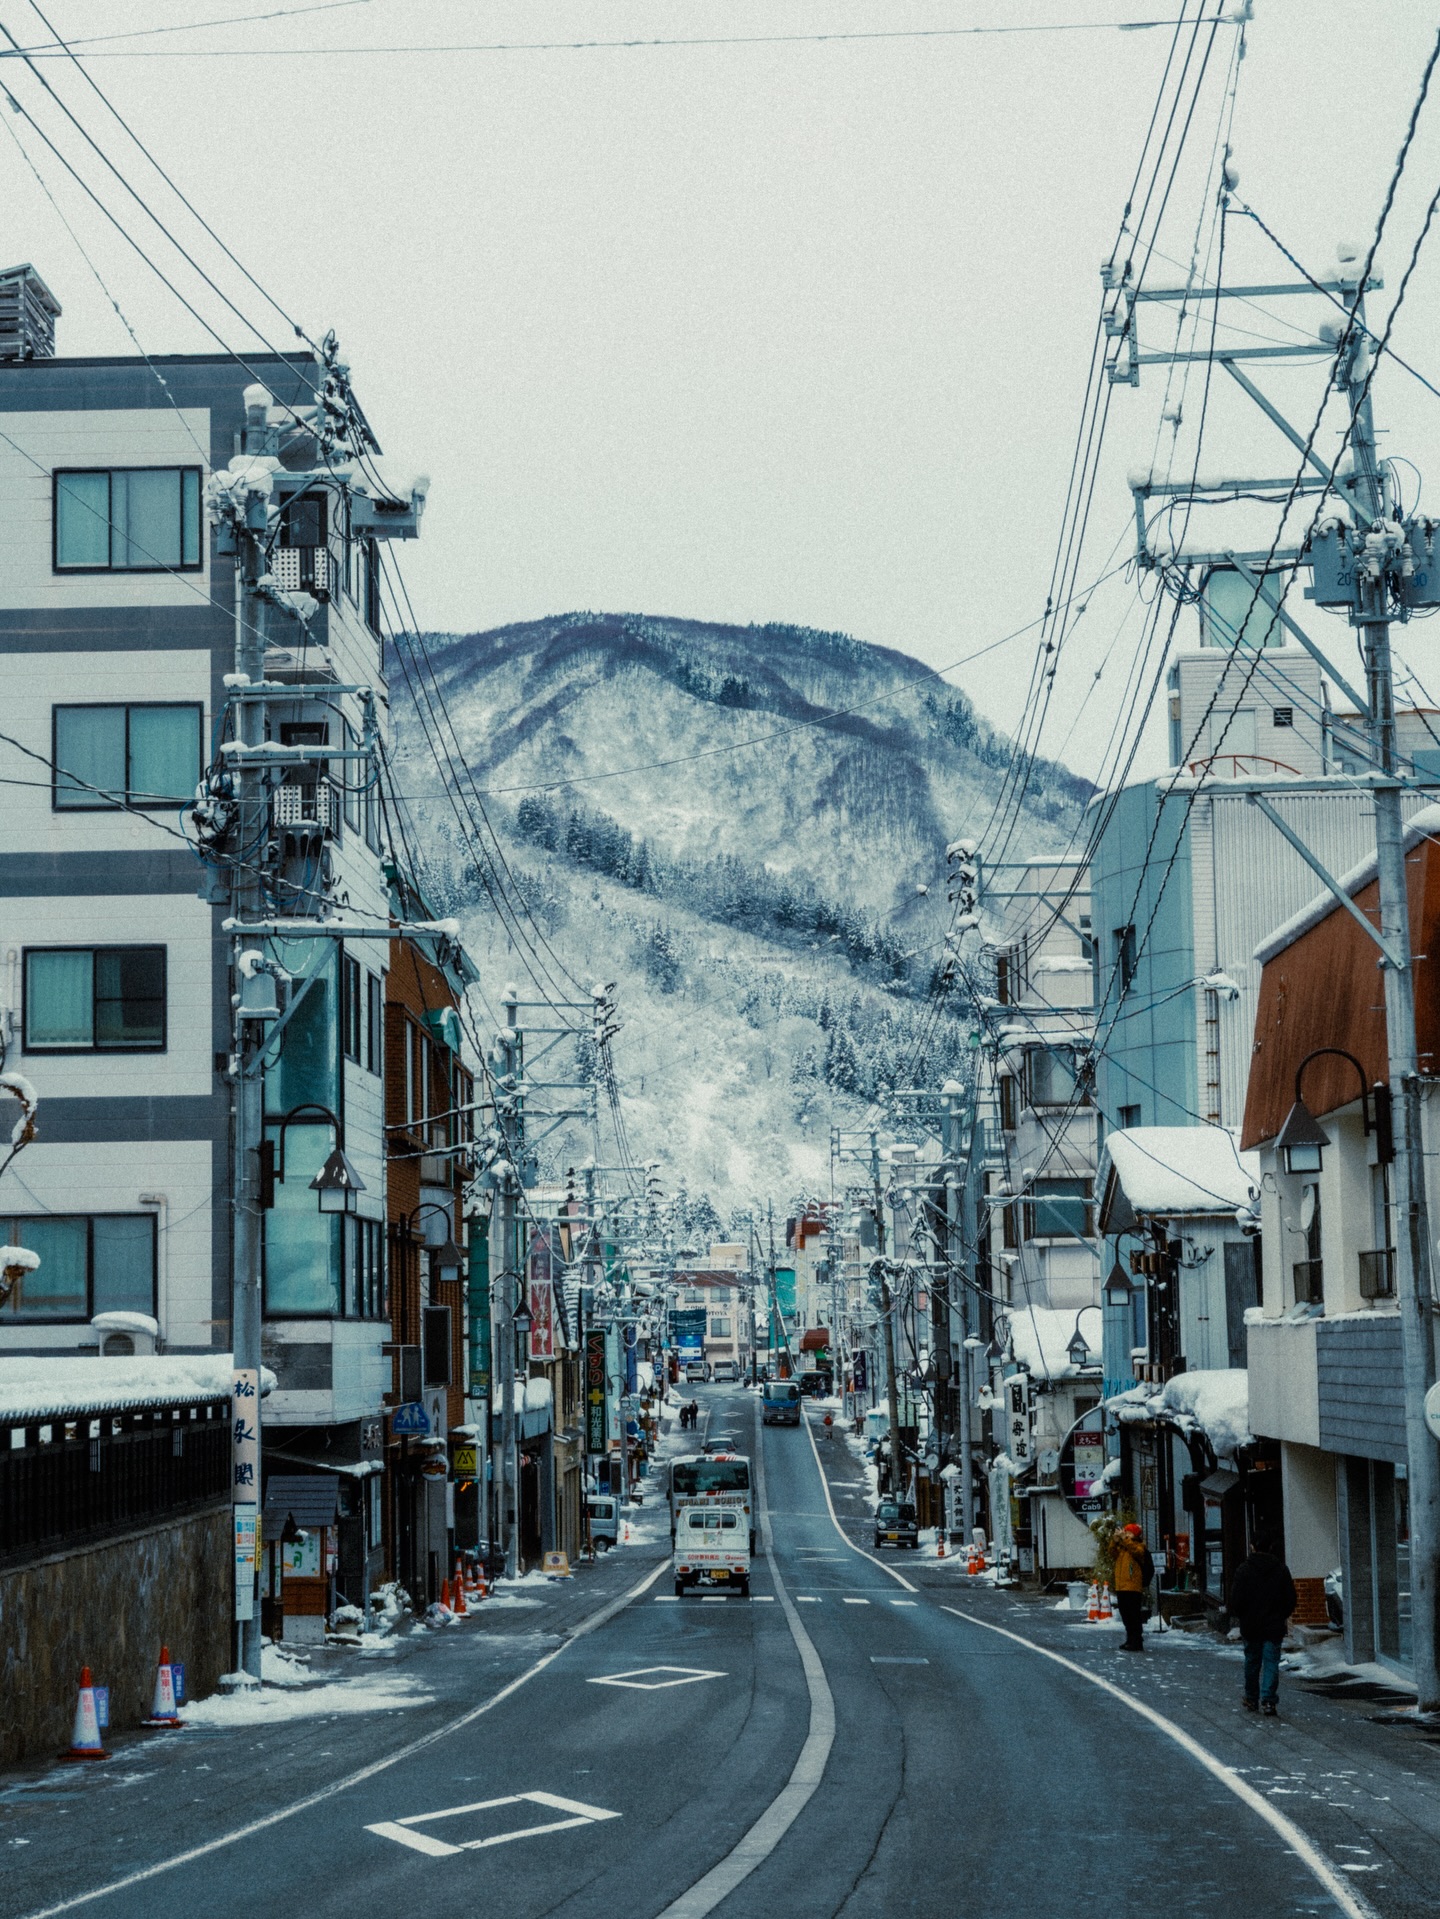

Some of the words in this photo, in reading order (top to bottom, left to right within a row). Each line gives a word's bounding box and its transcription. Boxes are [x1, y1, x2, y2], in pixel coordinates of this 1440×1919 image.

[1337, 572, 1351, 585] 20
[588, 1335, 604, 1386] くすり
[590, 1406, 602, 1449] 和光薬品
[1081, 1503, 1101, 1511] Cab9
